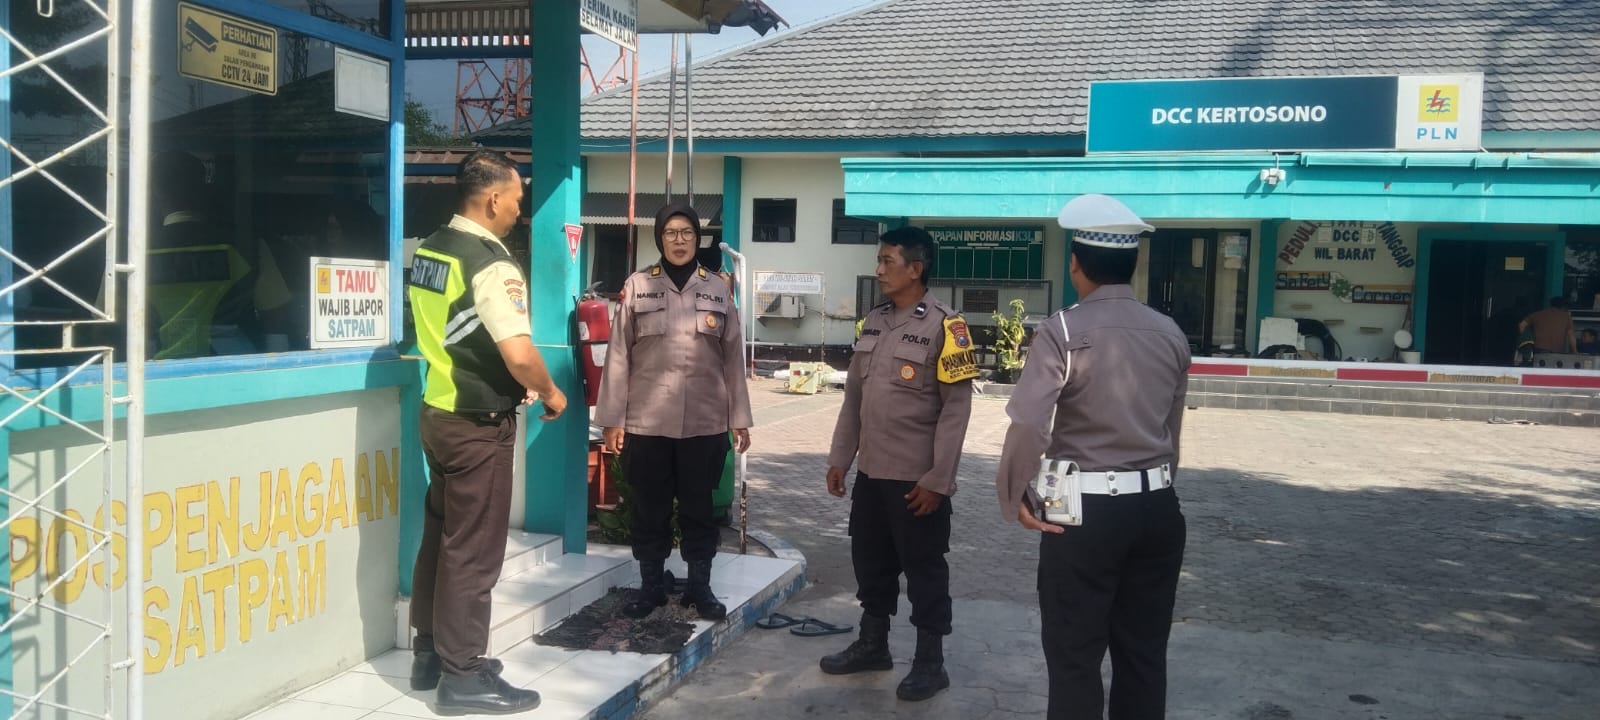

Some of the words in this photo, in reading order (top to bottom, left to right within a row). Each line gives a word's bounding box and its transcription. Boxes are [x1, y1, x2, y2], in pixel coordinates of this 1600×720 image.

[583, 0, 610, 20] TERIMA
[613, 8, 636, 32] KASIH
[223, 25, 272, 50] PERHATIAN
[582, 9, 612, 37] SELAMAT
[615, 26, 636, 48] JALAN
[222, 64, 240, 81] CCTV
[242, 69, 251, 84] 24
[253, 71, 269, 87] JAM
[1151, 108, 1193, 125] DCC
[1197, 105, 1327, 124] KERTOSONO
[1416, 127, 1459, 141] PLN
[934, 230, 963, 241] PAPAN
[964, 230, 1015, 242] INFORMASI
[1332, 229, 1360, 242] DCC
[1377, 221, 1415, 268] TANGGAP
[1314, 247, 1333, 260] WIL
[1337, 247, 1376, 261] BARAT
[335, 270, 377, 294] TAMU
[411, 257, 449, 292] SATPAM
[695, 292, 723, 303] POLRI
[1352, 285, 1412, 302] Corner
[318, 299, 351, 317] WAJIB
[353, 298, 384, 316] LAPOR
[328, 319, 376, 339] SATPAM
[902, 333, 931, 346] POLRI
[10, 500, 127, 613] POS
[144, 447, 399, 581] PENJAGAAN
[144, 540, 327, 675] SATPAM
